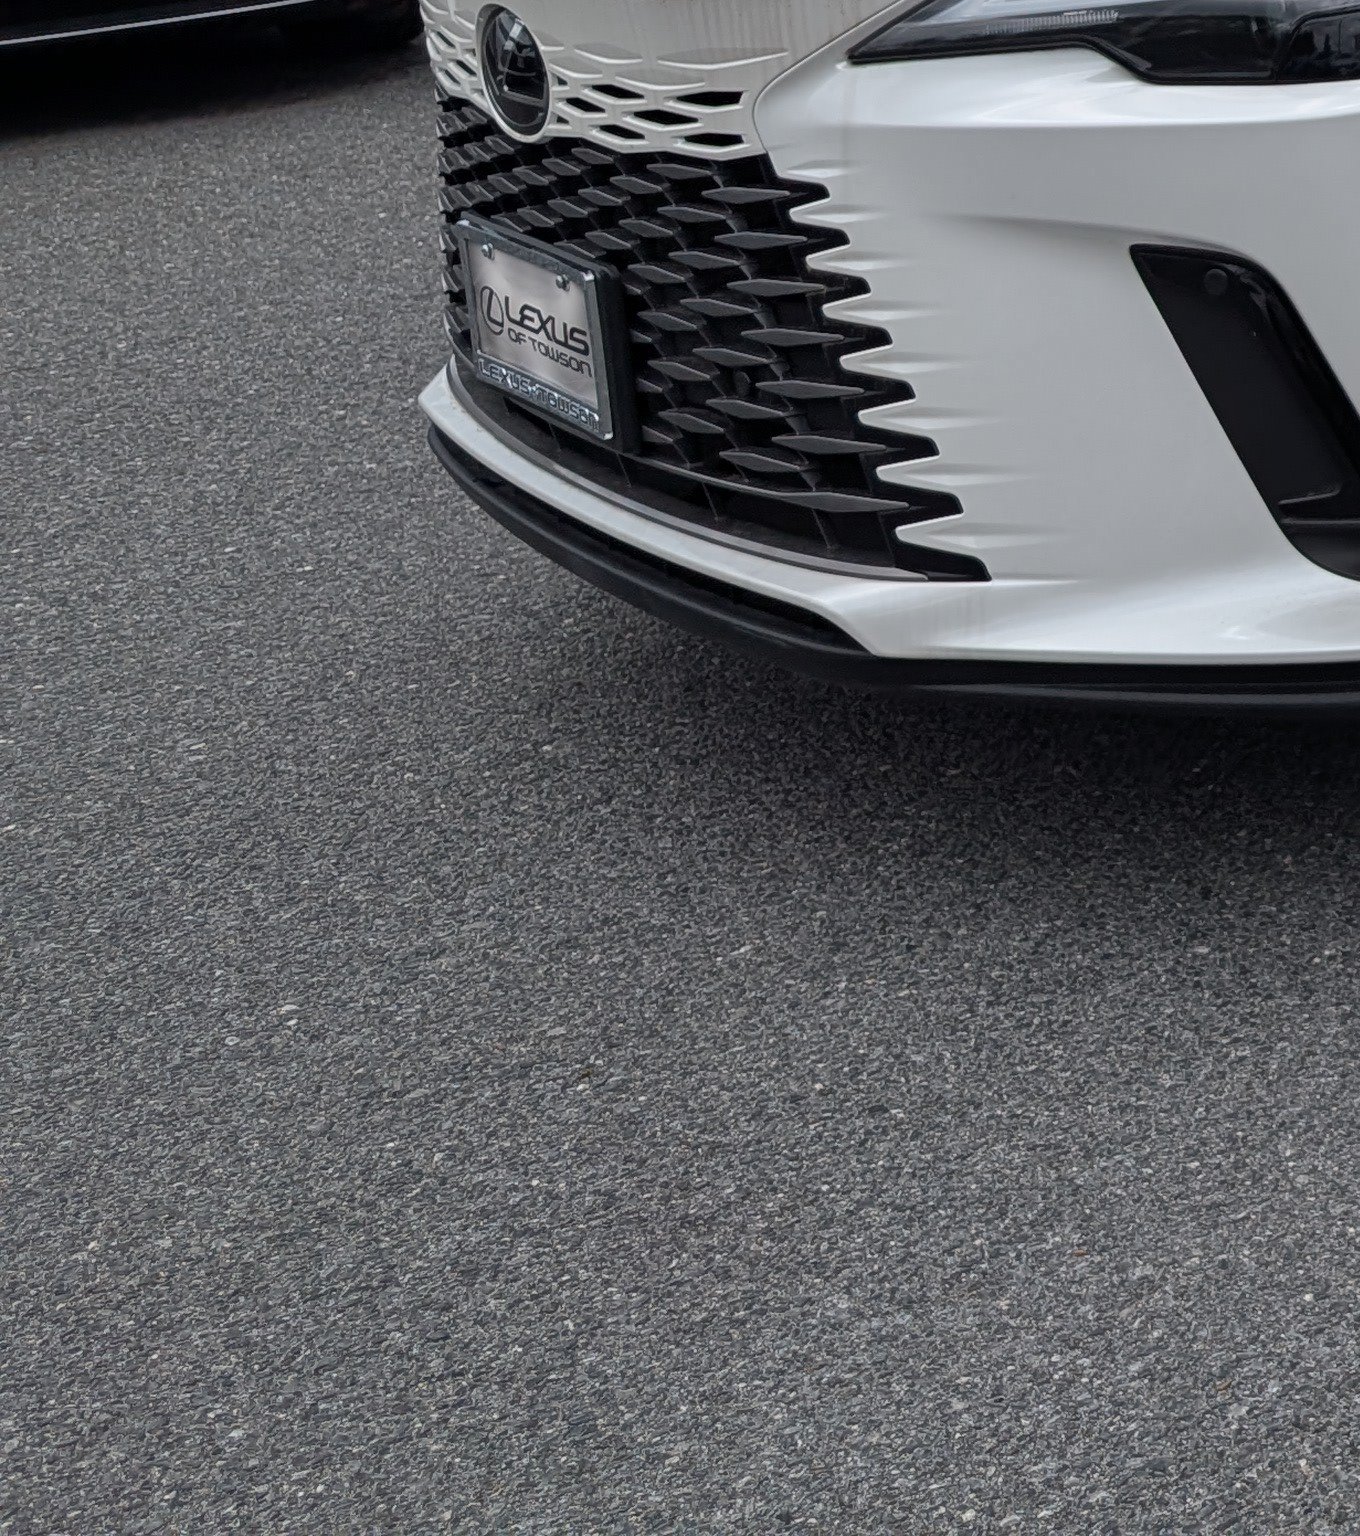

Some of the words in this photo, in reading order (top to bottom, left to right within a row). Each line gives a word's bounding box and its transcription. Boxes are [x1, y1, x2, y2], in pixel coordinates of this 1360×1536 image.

[503, 295, 590, 356] LEXUS
[478, 358, 531, 396] LEXUS
[507, 327, 527, 346] OF
[527, 336, 593, 378] TOWSON
